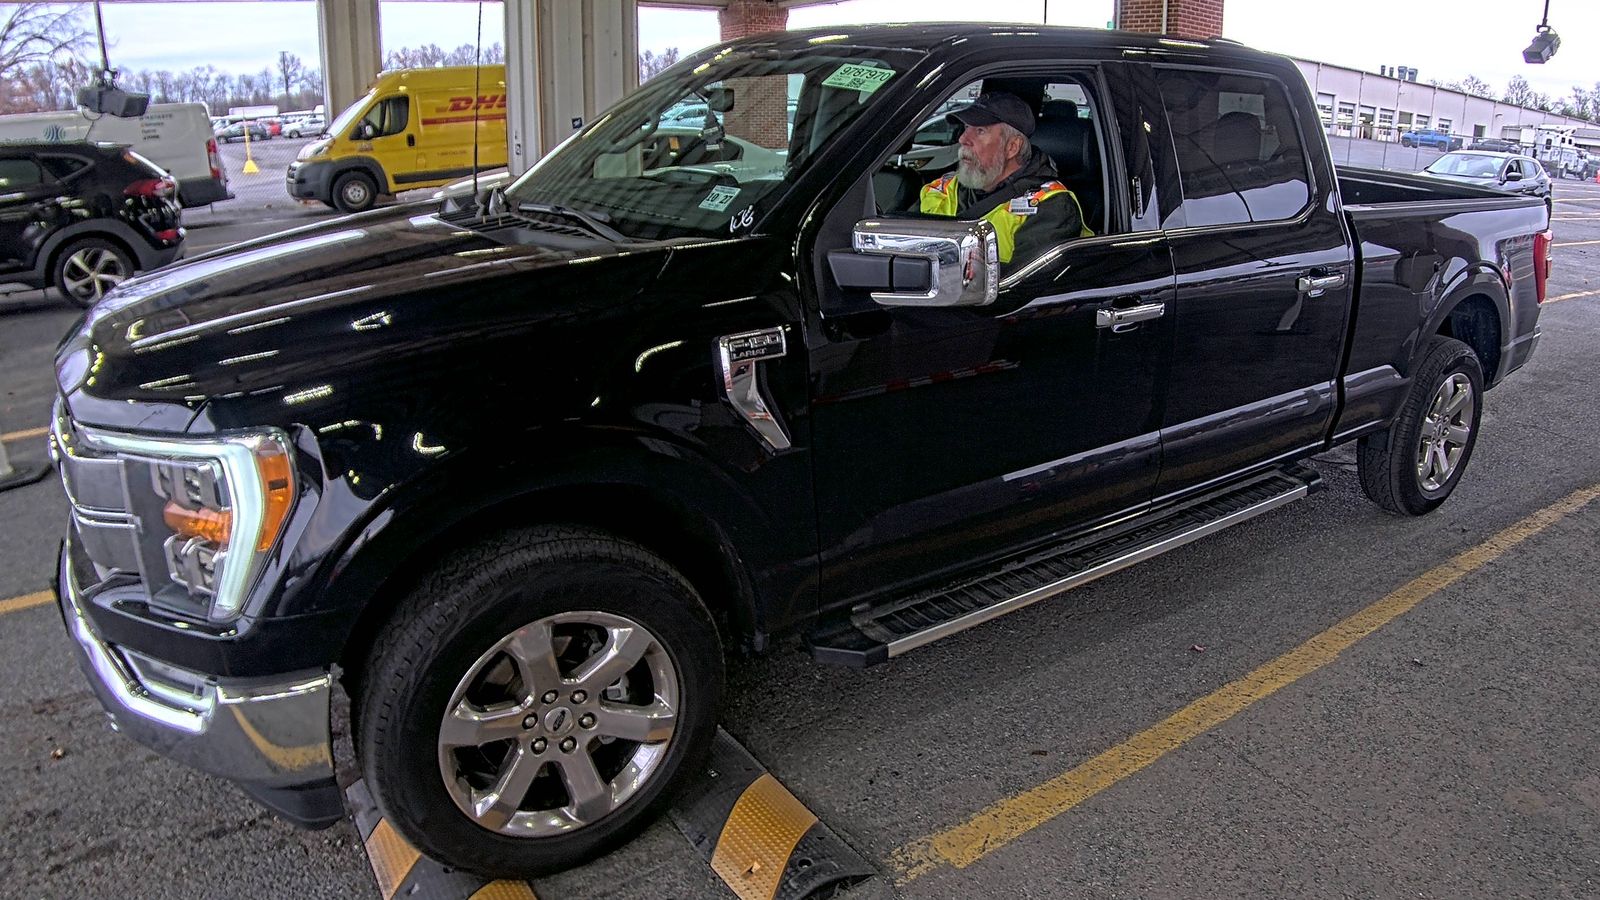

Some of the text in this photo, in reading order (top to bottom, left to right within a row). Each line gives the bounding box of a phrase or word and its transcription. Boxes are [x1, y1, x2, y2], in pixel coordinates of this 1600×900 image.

[840, 66, 891, 82] 9787970
[706, 192, 734, 204] 10 27
[728, 333, 781, 352] F-150
[732, 347, 768, 360] LARIAT
